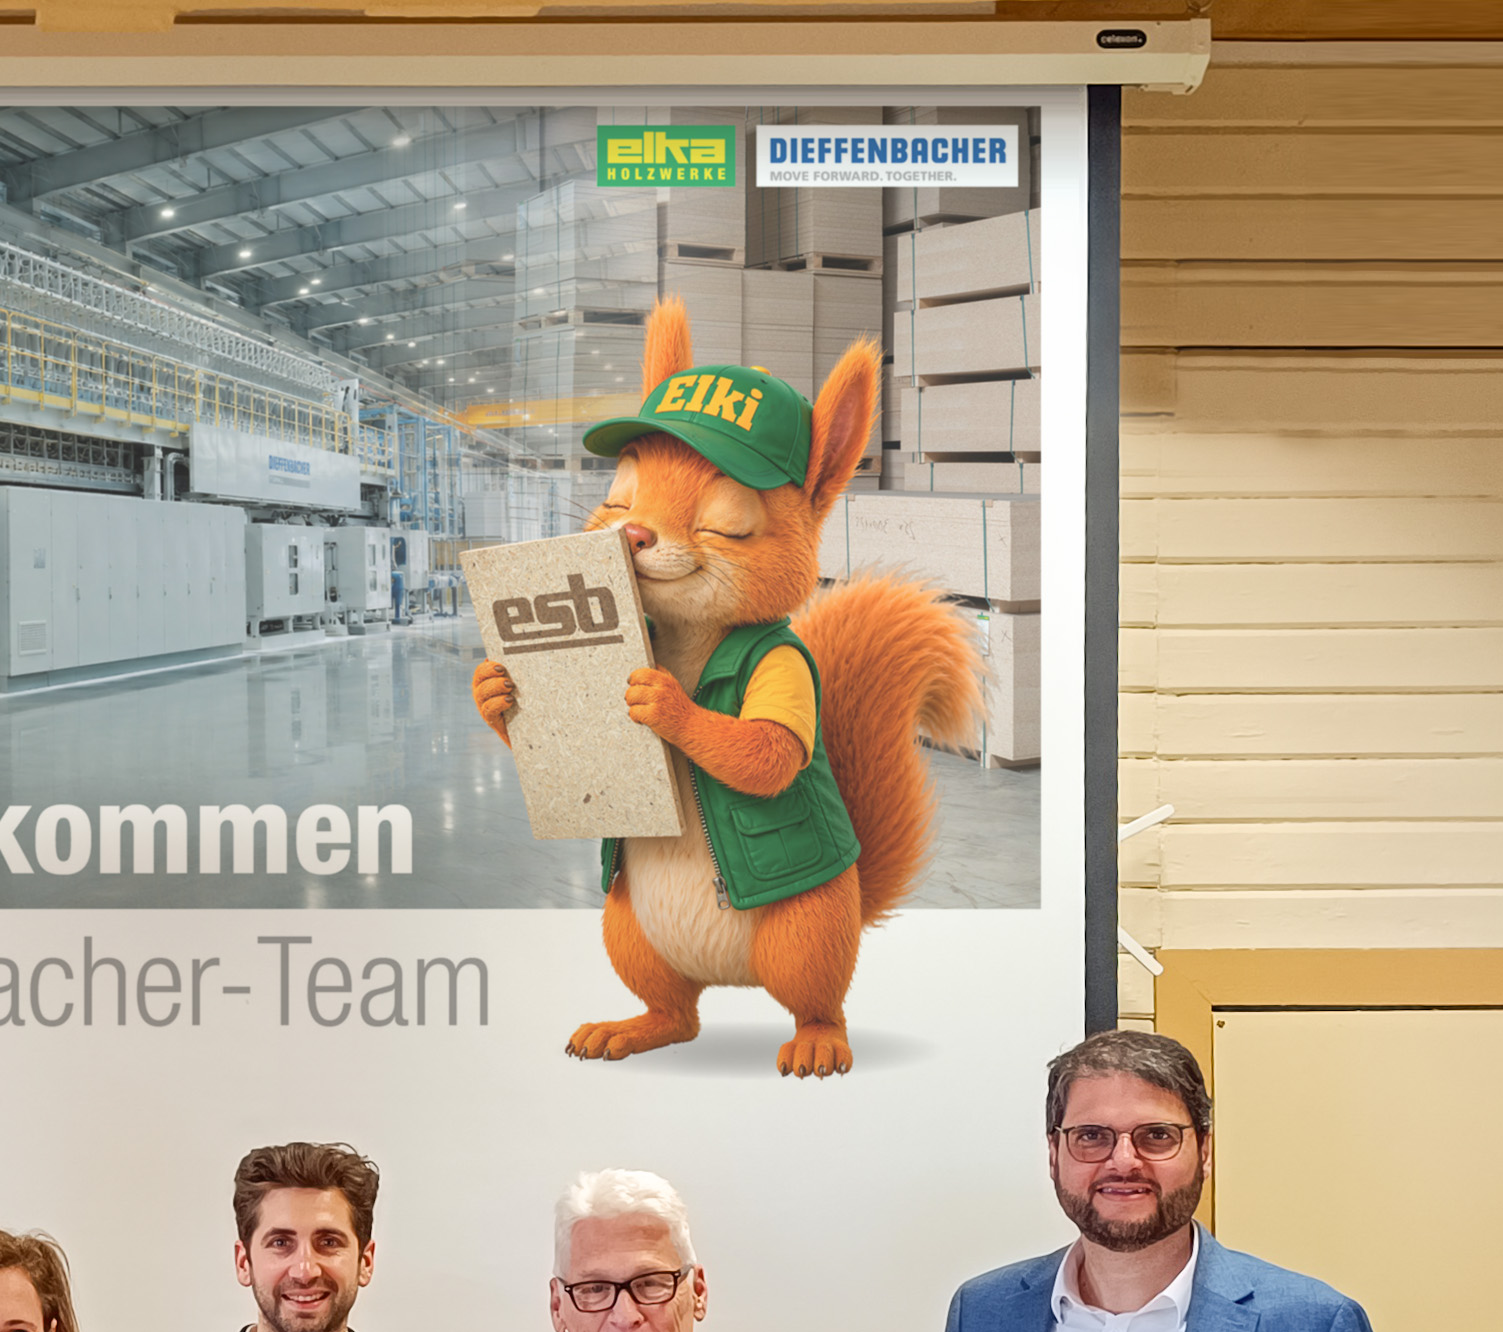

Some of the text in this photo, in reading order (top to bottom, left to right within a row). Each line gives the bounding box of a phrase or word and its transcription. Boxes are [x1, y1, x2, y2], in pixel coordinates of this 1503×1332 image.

[607, 131, 726, 164] elka
[769, 137, 1007, 164] DIEFFENBACHER
[607, 167, 726, 180] HOLZWERKE
[769, 171, 957, 182] MOVE FORWARD. TOGETHER.
[654, 374, 763, 432] Elki
[492, 573, 620, 643] esb
